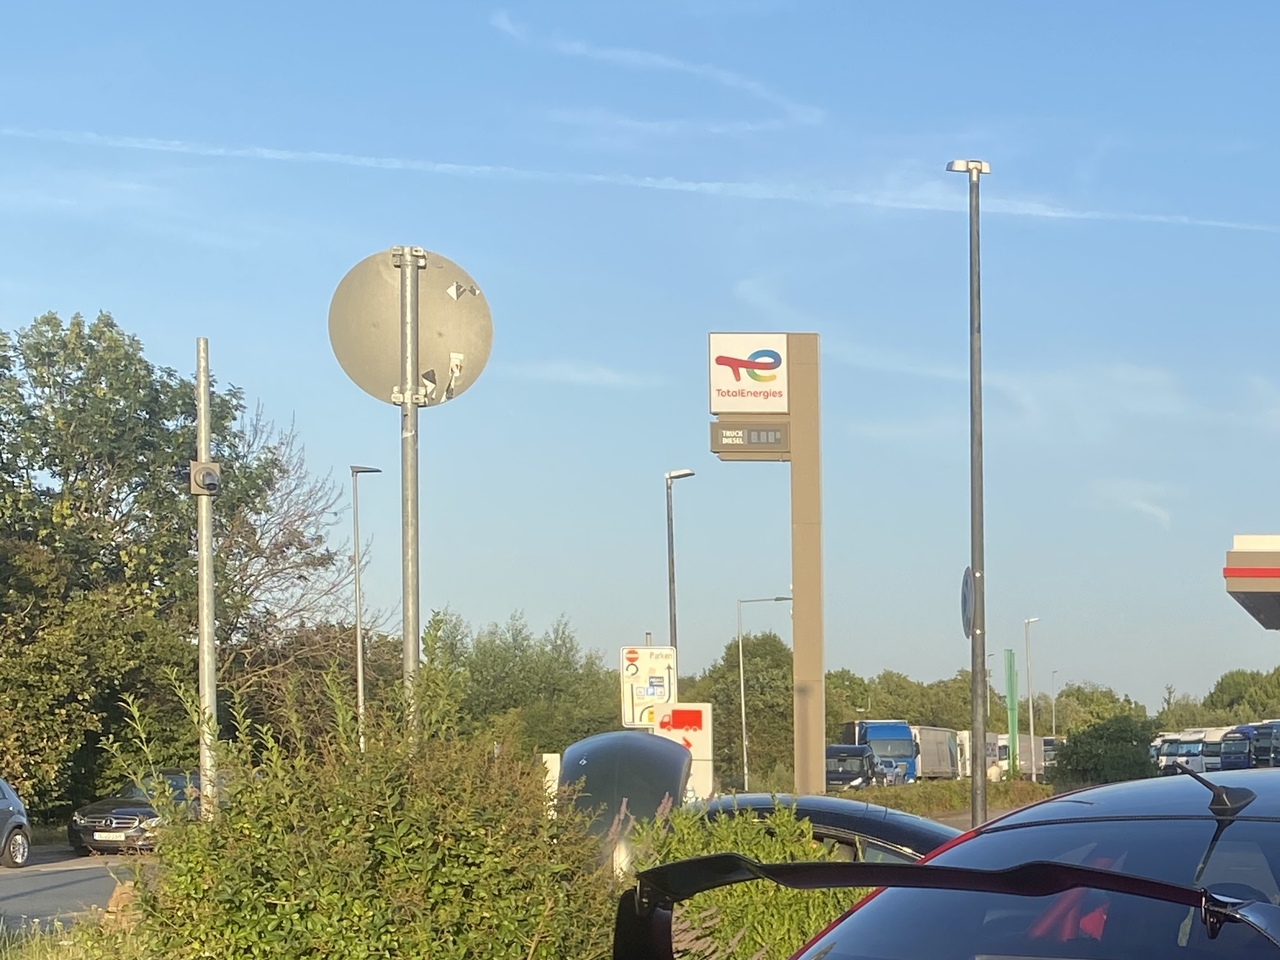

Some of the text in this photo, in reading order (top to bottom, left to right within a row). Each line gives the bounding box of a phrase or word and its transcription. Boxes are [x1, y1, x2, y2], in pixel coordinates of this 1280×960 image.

[715, 388, 783, 400] TotalEnergies
[722, 437, 744, 445] DIESEL
[649, 651, 672, 660] Parken
